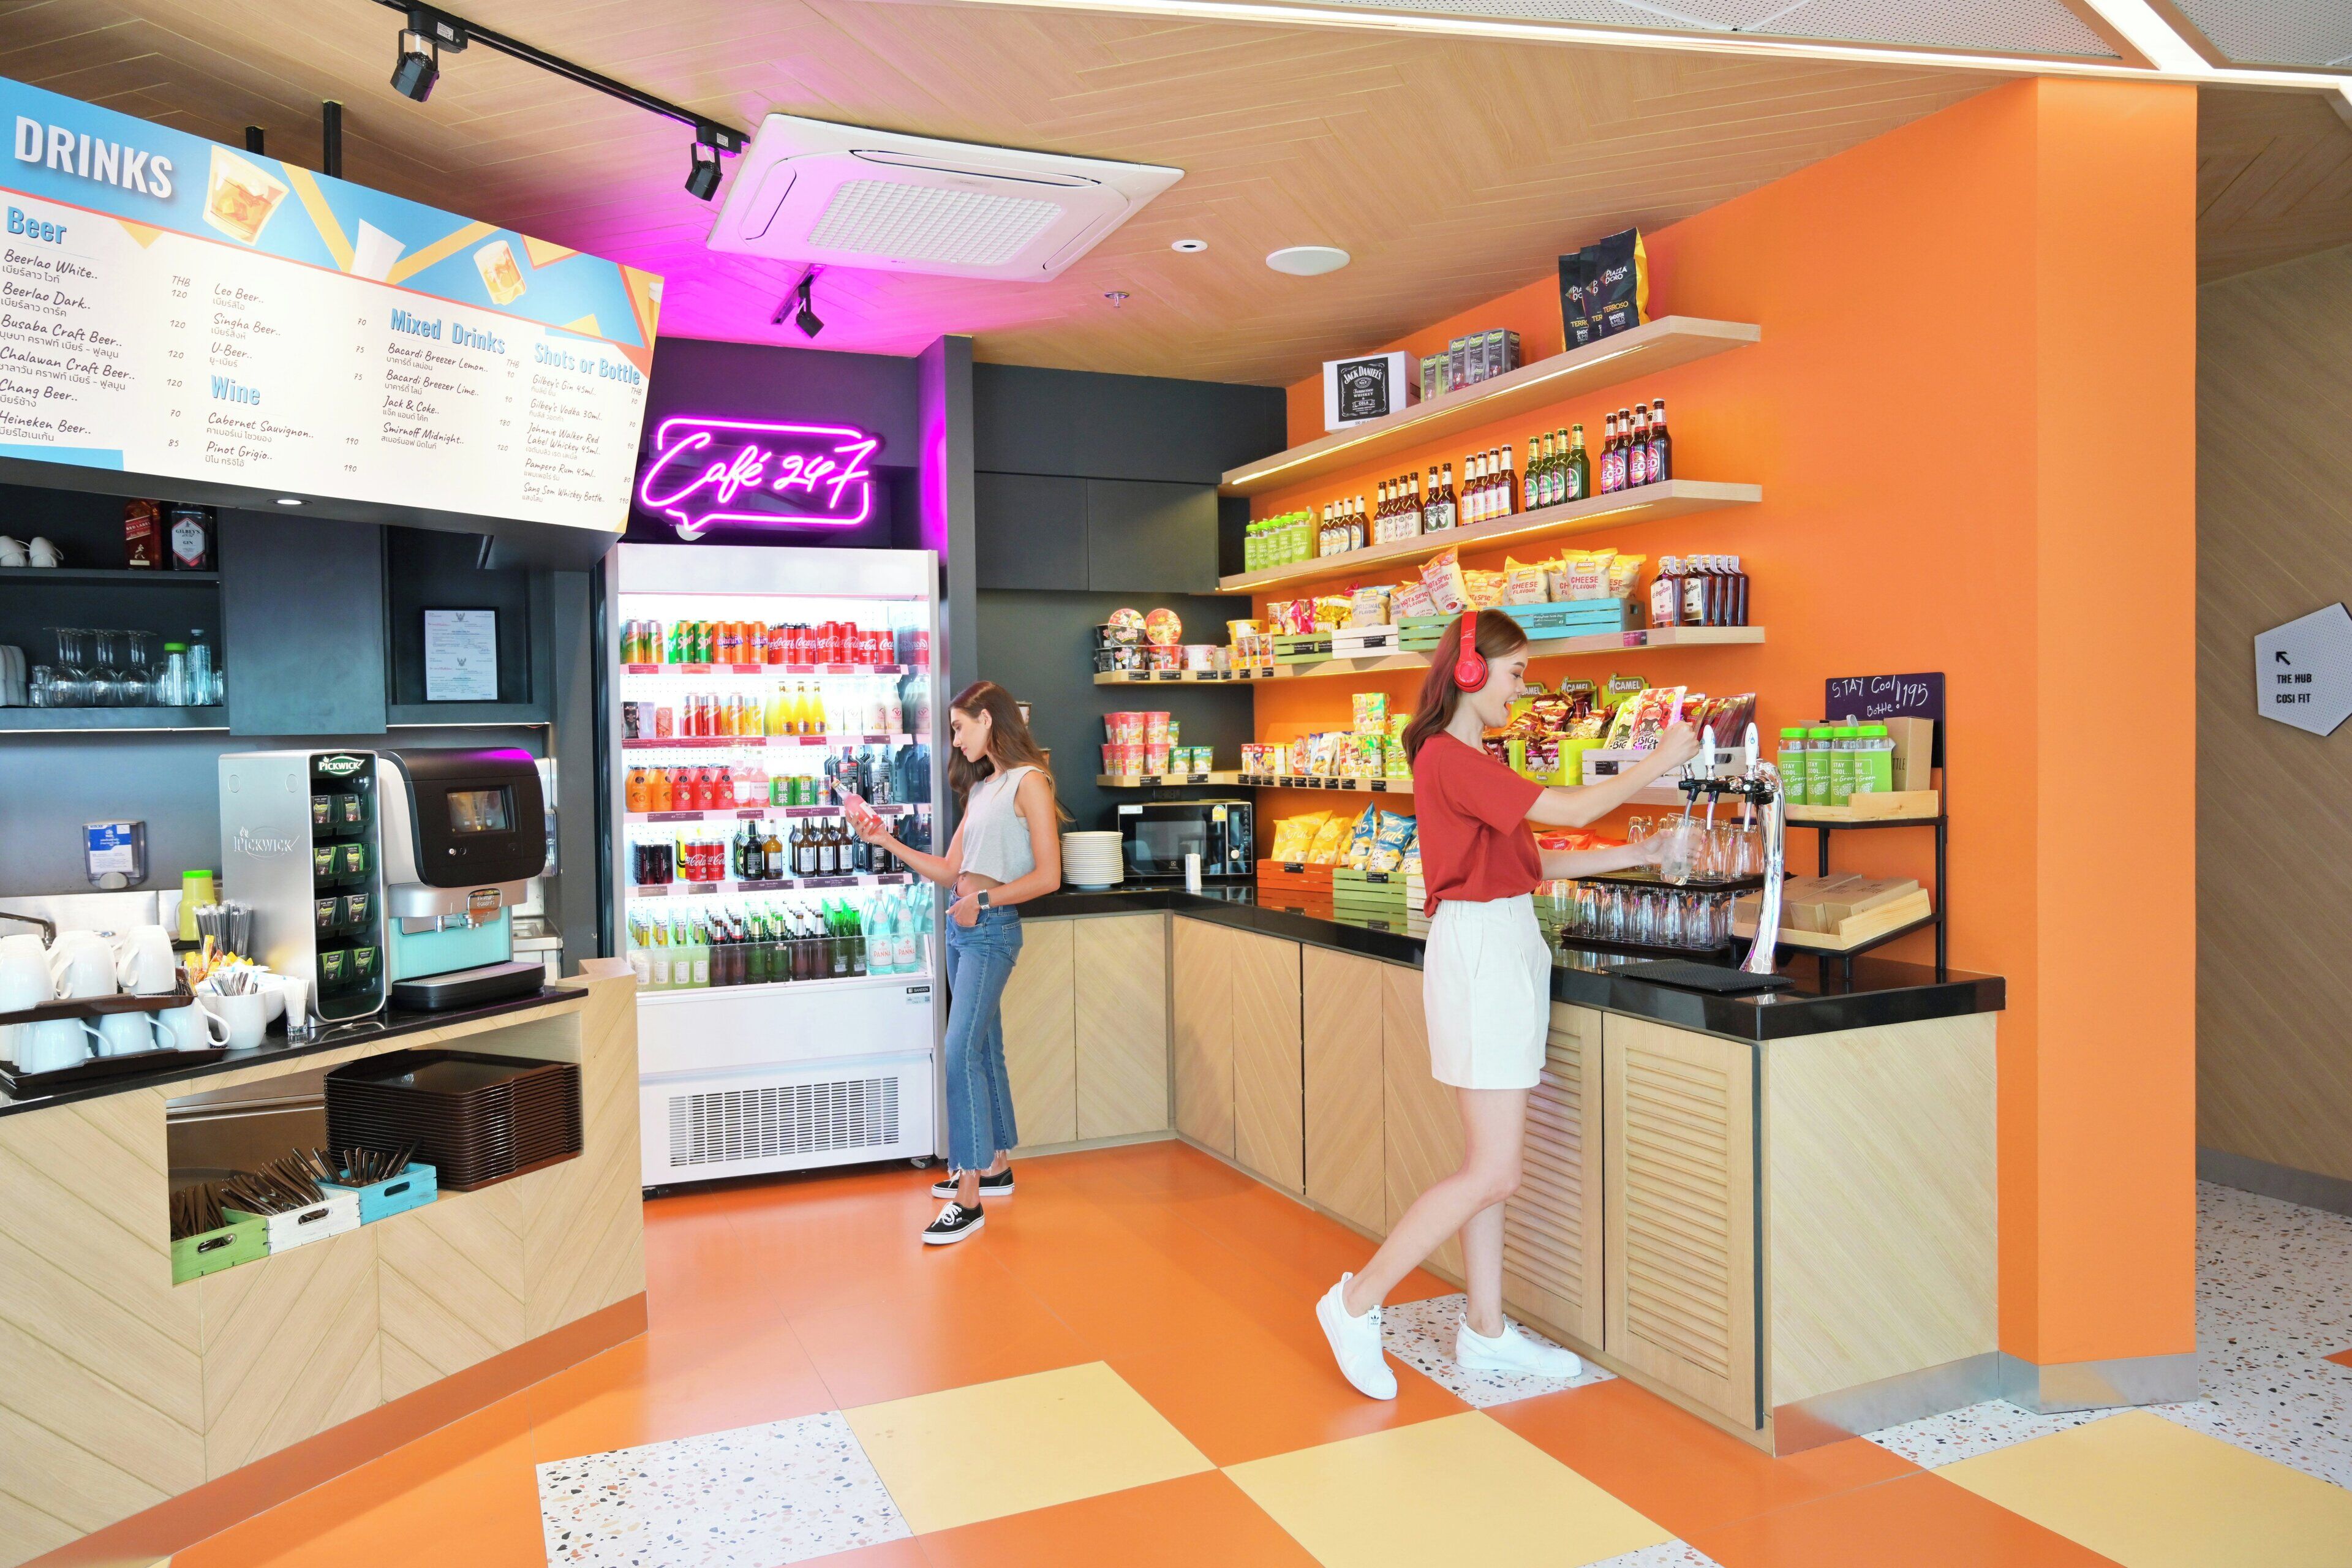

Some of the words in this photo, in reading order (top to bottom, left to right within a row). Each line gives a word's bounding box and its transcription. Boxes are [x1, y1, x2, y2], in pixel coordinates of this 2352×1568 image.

[14, 115, 173, 198] DRINKS
[6, 206, 67, 244] Beer
[4, 249, 51, 269] Beerlao
[1606, 267, 1627, 277] PIAZZA
[172, 276, 190, 287] THB
[214, 283, 232, 296] Leo
[2, 282, 49, 301] Beerlao
[172, 290, 187, 298] 120
[1603, 301, 1628, 313] TERROSO
[1, 314, 48, 333] Busaba
[52, 324, 85, 341] Craft
[170, 320, 185, 328] 120
[214, 312, 249, 330] Singha
[391, 308, 441, 340] Mixed
[452, 322, 505, 355] Drinks
[0, 346, 61, 368] Chalawan
[66, 358, 99, 375] Craft
[168, 350, 184, 359] 120
[388, 343, 423, 358] Bacardi
[425, 351, 456, 366] Breezer
[507, 359, 519, 368] THB
[534, 342, 575, 371] Shots
[580, 358, 594, 374] or
[599, 358, 640, 385] Bottle
[386, 369, 421, 385] Bacardi
[423, 377, 454, 391] Breezer
[533, 374, 559, 389] Gilbey's
[562, 381, 573, 391] Gin
[1344, 370, 1357, 384] JACK
[1359, 366, 1382, 380] DANIEL'S
[0, 379, 39, 399] Chang
[211, 374, 260, 405] Wine
[383, 396, 404, 408] Jack
[406, 400, 413, 411] &
[530, 399, 557, 413] Gilbey's
[560, 405, 580, 416] Vodka
[0, 410, 53, 429] Heineken
[208, 412, 255, 429] Cabernet
[383, 422, 421, 439] Smirnoff
[527, 423, 556, 436] Johnnie
[559, 429, 583, 440] Walker
[586, 434, 599, 443] Red
[206, 441, 235, 455] Pinot
[527, 434, 548, 445] Label
[550, 439, 578, 453] Whiskey
[526, 458, 556, 471] Pampero
[559, 464, 573, 473] Rum
[641, 431, 772, 507] Café
[524, 483, 540, 494] Sang
[541, 486, 555, 495] Som
[558, 488, 581, 501] Whiskey
[1438, 573, 1452, 583] SPICY
[1512, 581, 1538, 590] CHEESE
[1432, 582, 1449, 593] FLAVOUR
[1401, 598, 1411, 607] HOT
[1407, 598, 1427, 609] FLAVOUR
[1615, 680, 1640, 691] CAMEL
[2277, 674, 2292, 684] THE
[2295, 674, 2312, 683] HUB
[1902, 684, 1928, 707] 195
[2276, 694, 2295, 703] COSI
[2298, 693, 2310, 703] FIT
[1867, 702, 1893, 717] Bottle
[1613, 741, 1627, 749] BIG
[1638, 736, 1653, 744] BIG
[319, 760, 364, 770] PICKWICK
[1893, 758, 1905, 771] TTLE
[234, 835, 299, 853] PICKWICK
